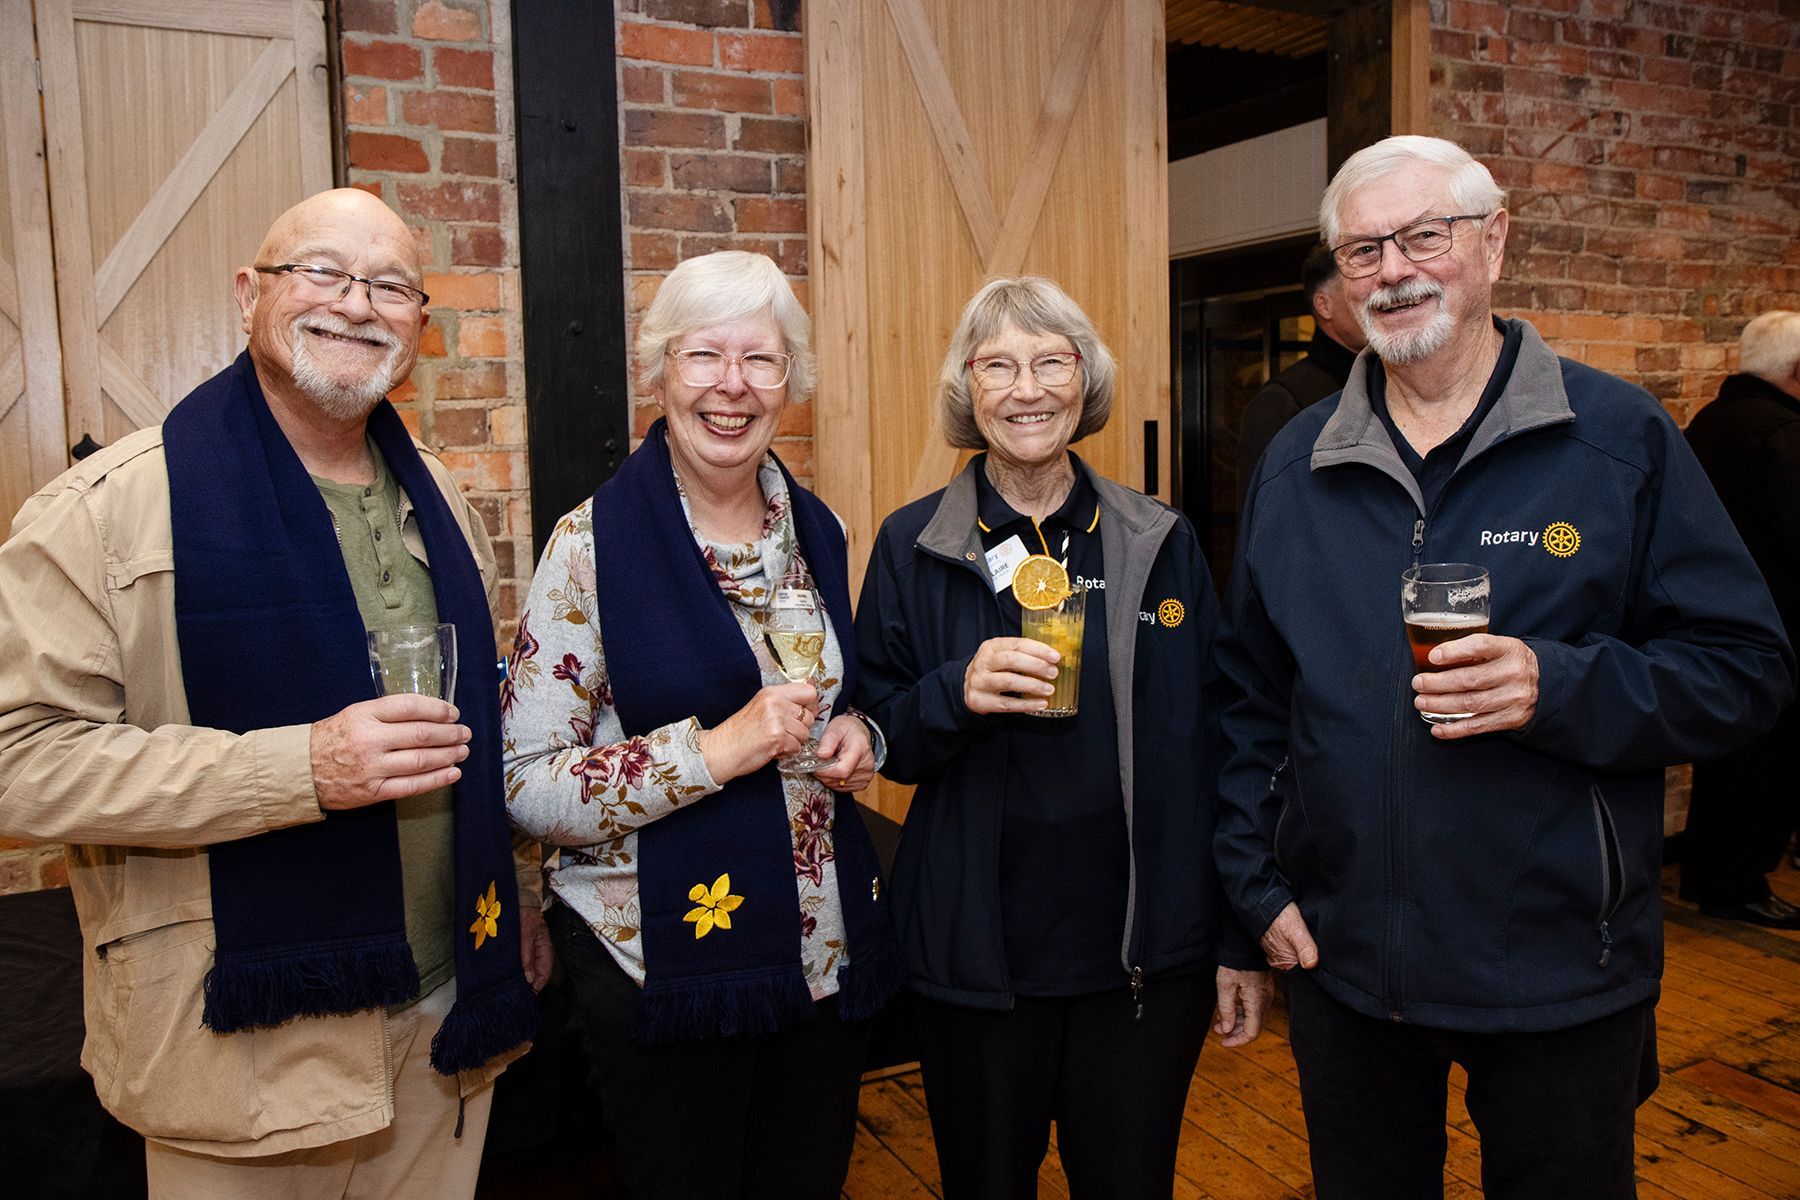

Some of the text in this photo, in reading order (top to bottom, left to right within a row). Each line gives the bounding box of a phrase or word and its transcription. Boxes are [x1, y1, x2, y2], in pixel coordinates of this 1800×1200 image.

[1480, 530, 1540, 547] Rotary
[991, 562, 1009, 577] LAIRE
[1076, 575, 1106, 589] Rota
